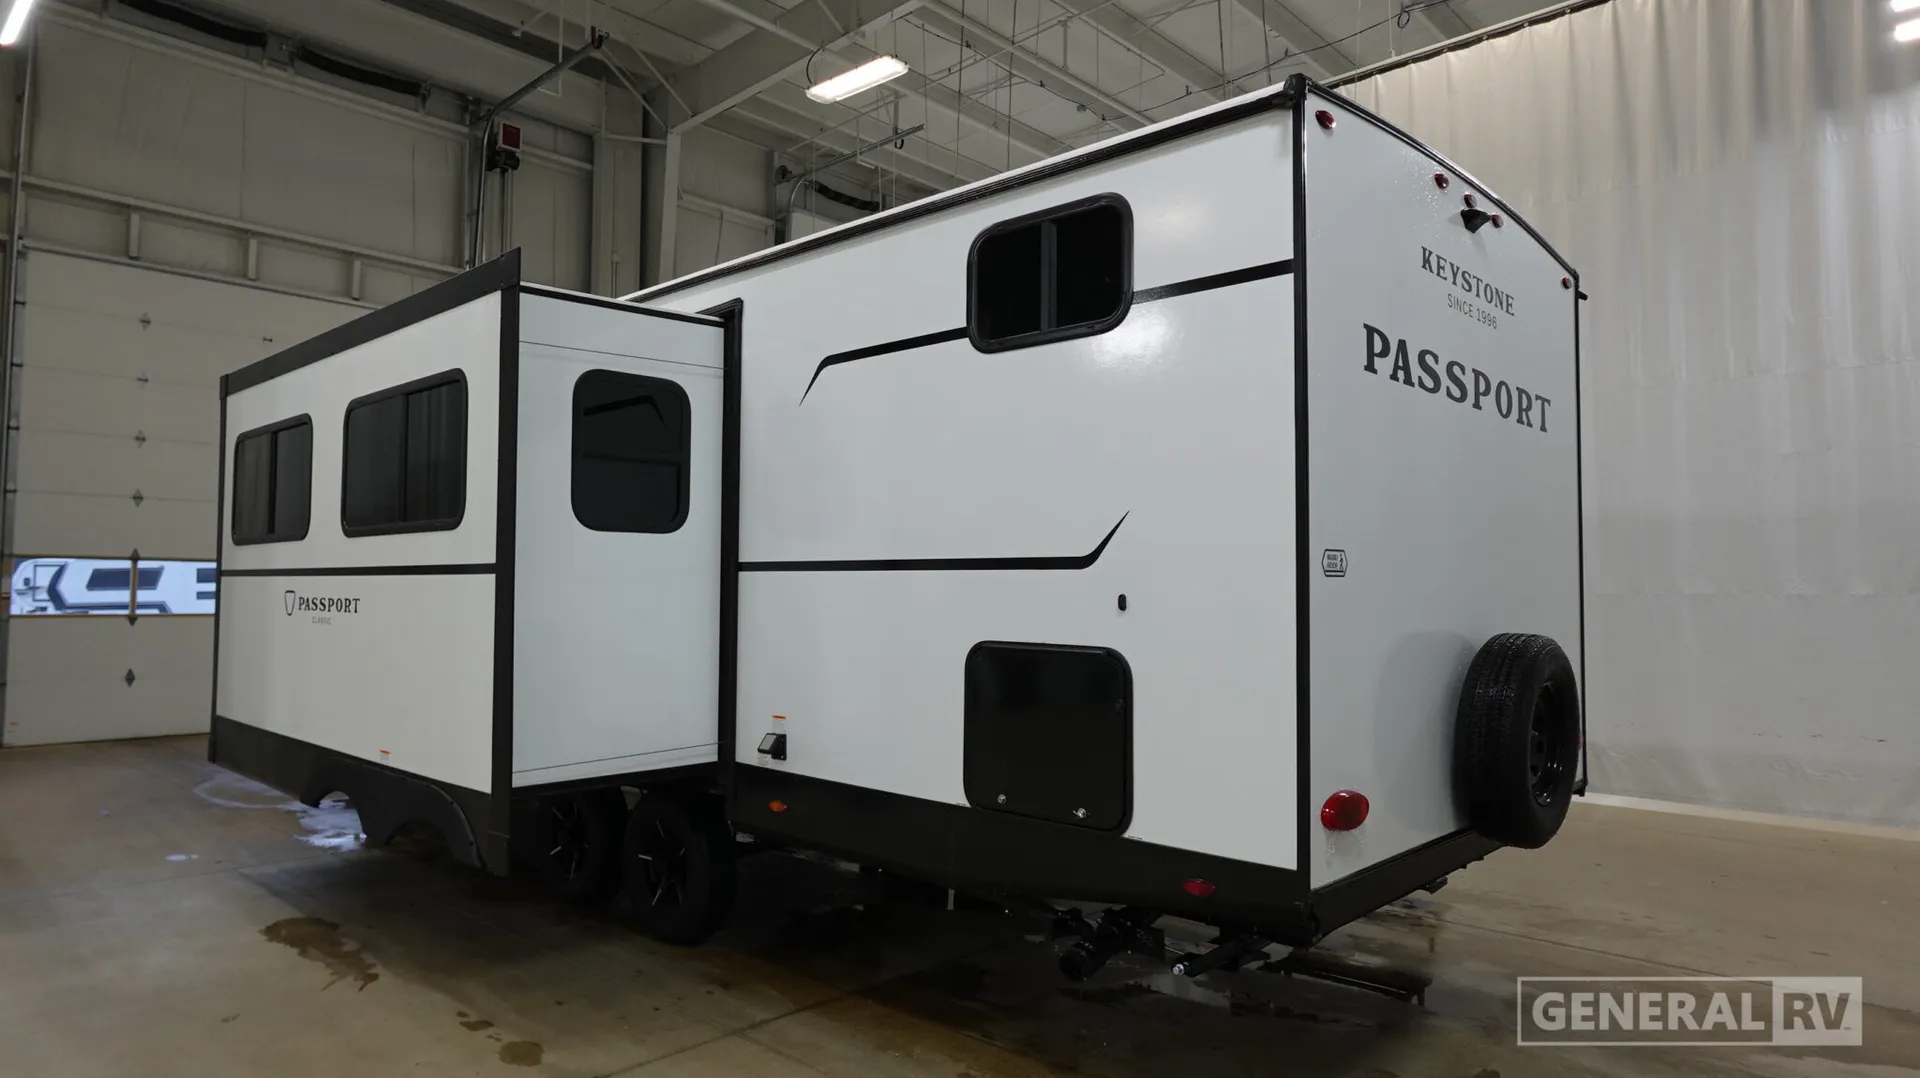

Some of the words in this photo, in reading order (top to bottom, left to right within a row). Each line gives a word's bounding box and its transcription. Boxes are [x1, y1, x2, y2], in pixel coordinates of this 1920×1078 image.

[1421, 246, 1515, 316] KEYSTONE
[1447, 293, 1474, 318] SINCE
[1477, 308, 1497, 329] 1996
[1363, 323, 1551, 433] PASSPORT
[298, 596, 360, 613] PASSPORT
